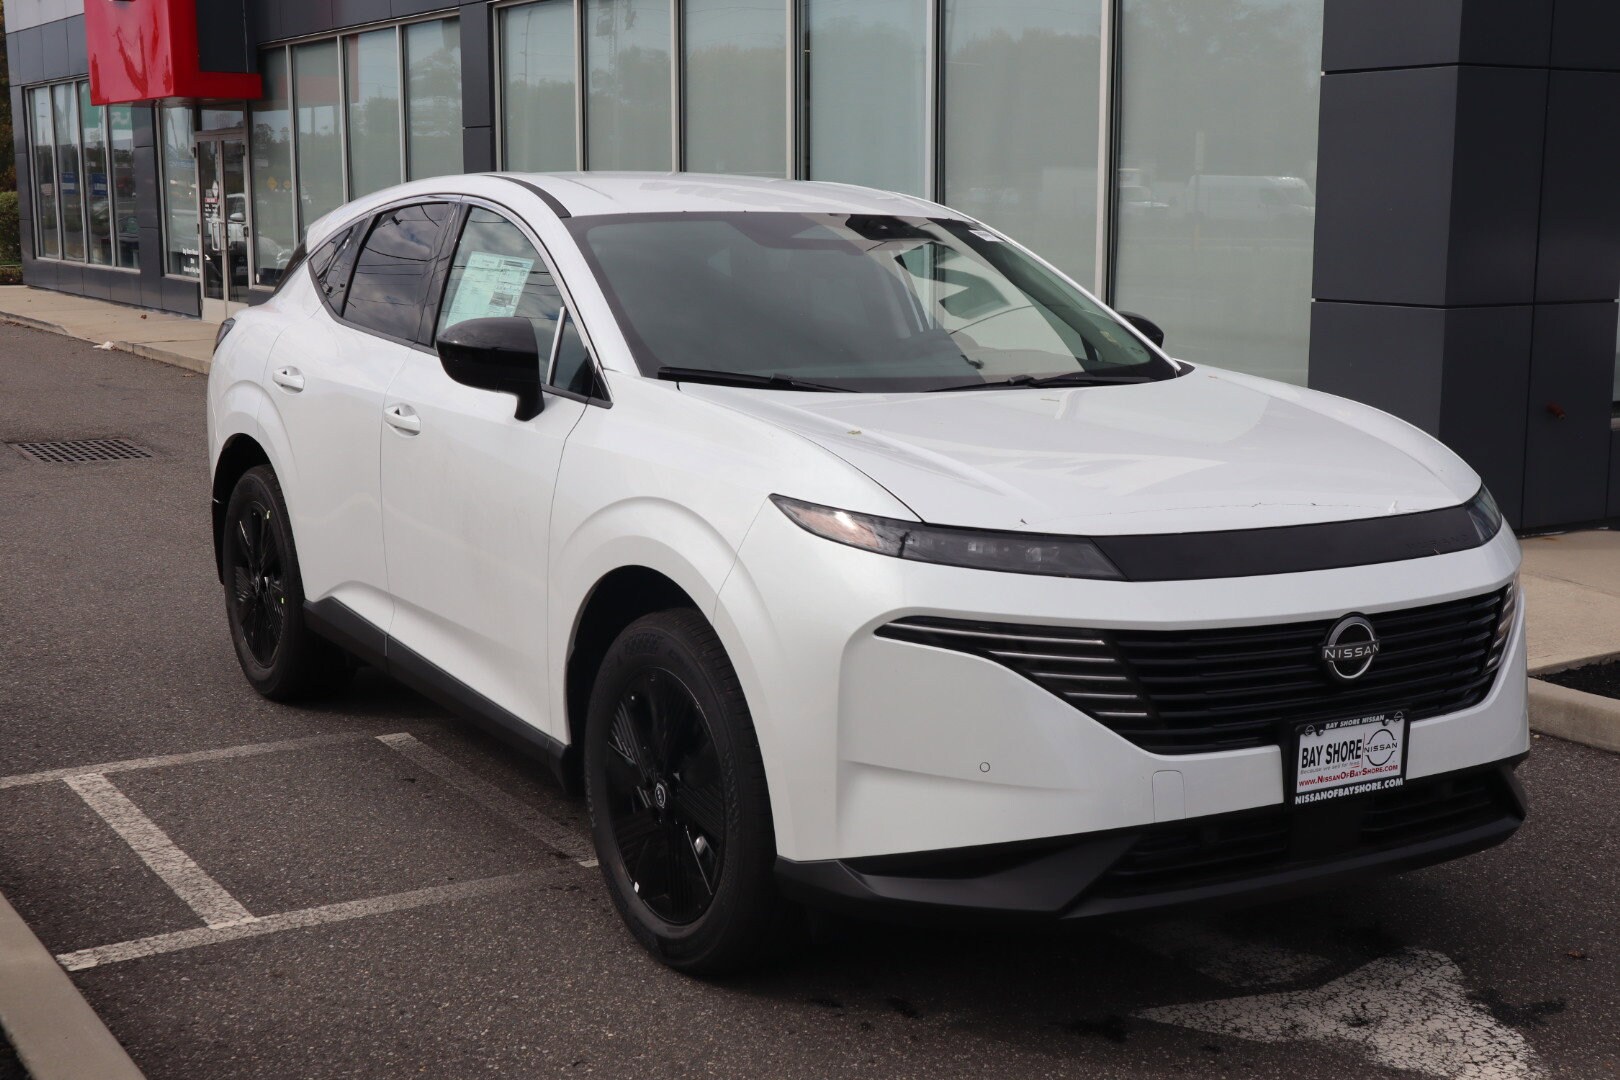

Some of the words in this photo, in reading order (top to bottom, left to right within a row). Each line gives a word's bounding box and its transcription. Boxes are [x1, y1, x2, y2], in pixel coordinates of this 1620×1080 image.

[1324, 643, 1379, 659] NISSAN
[1325, 721, 1339, 730] BAY
[1340, 718, 1360, 727] SHORE
[1362, 714, 1385, 724] NISSAN
[1301, 745, 1324, 768] BAY
[1325, 739, 1362, 765] SHORE
[1363, 742, 1398, 753] NISSAN
[1295, 777, 1404, 805] NISSANOFBAYSHORE.COM
